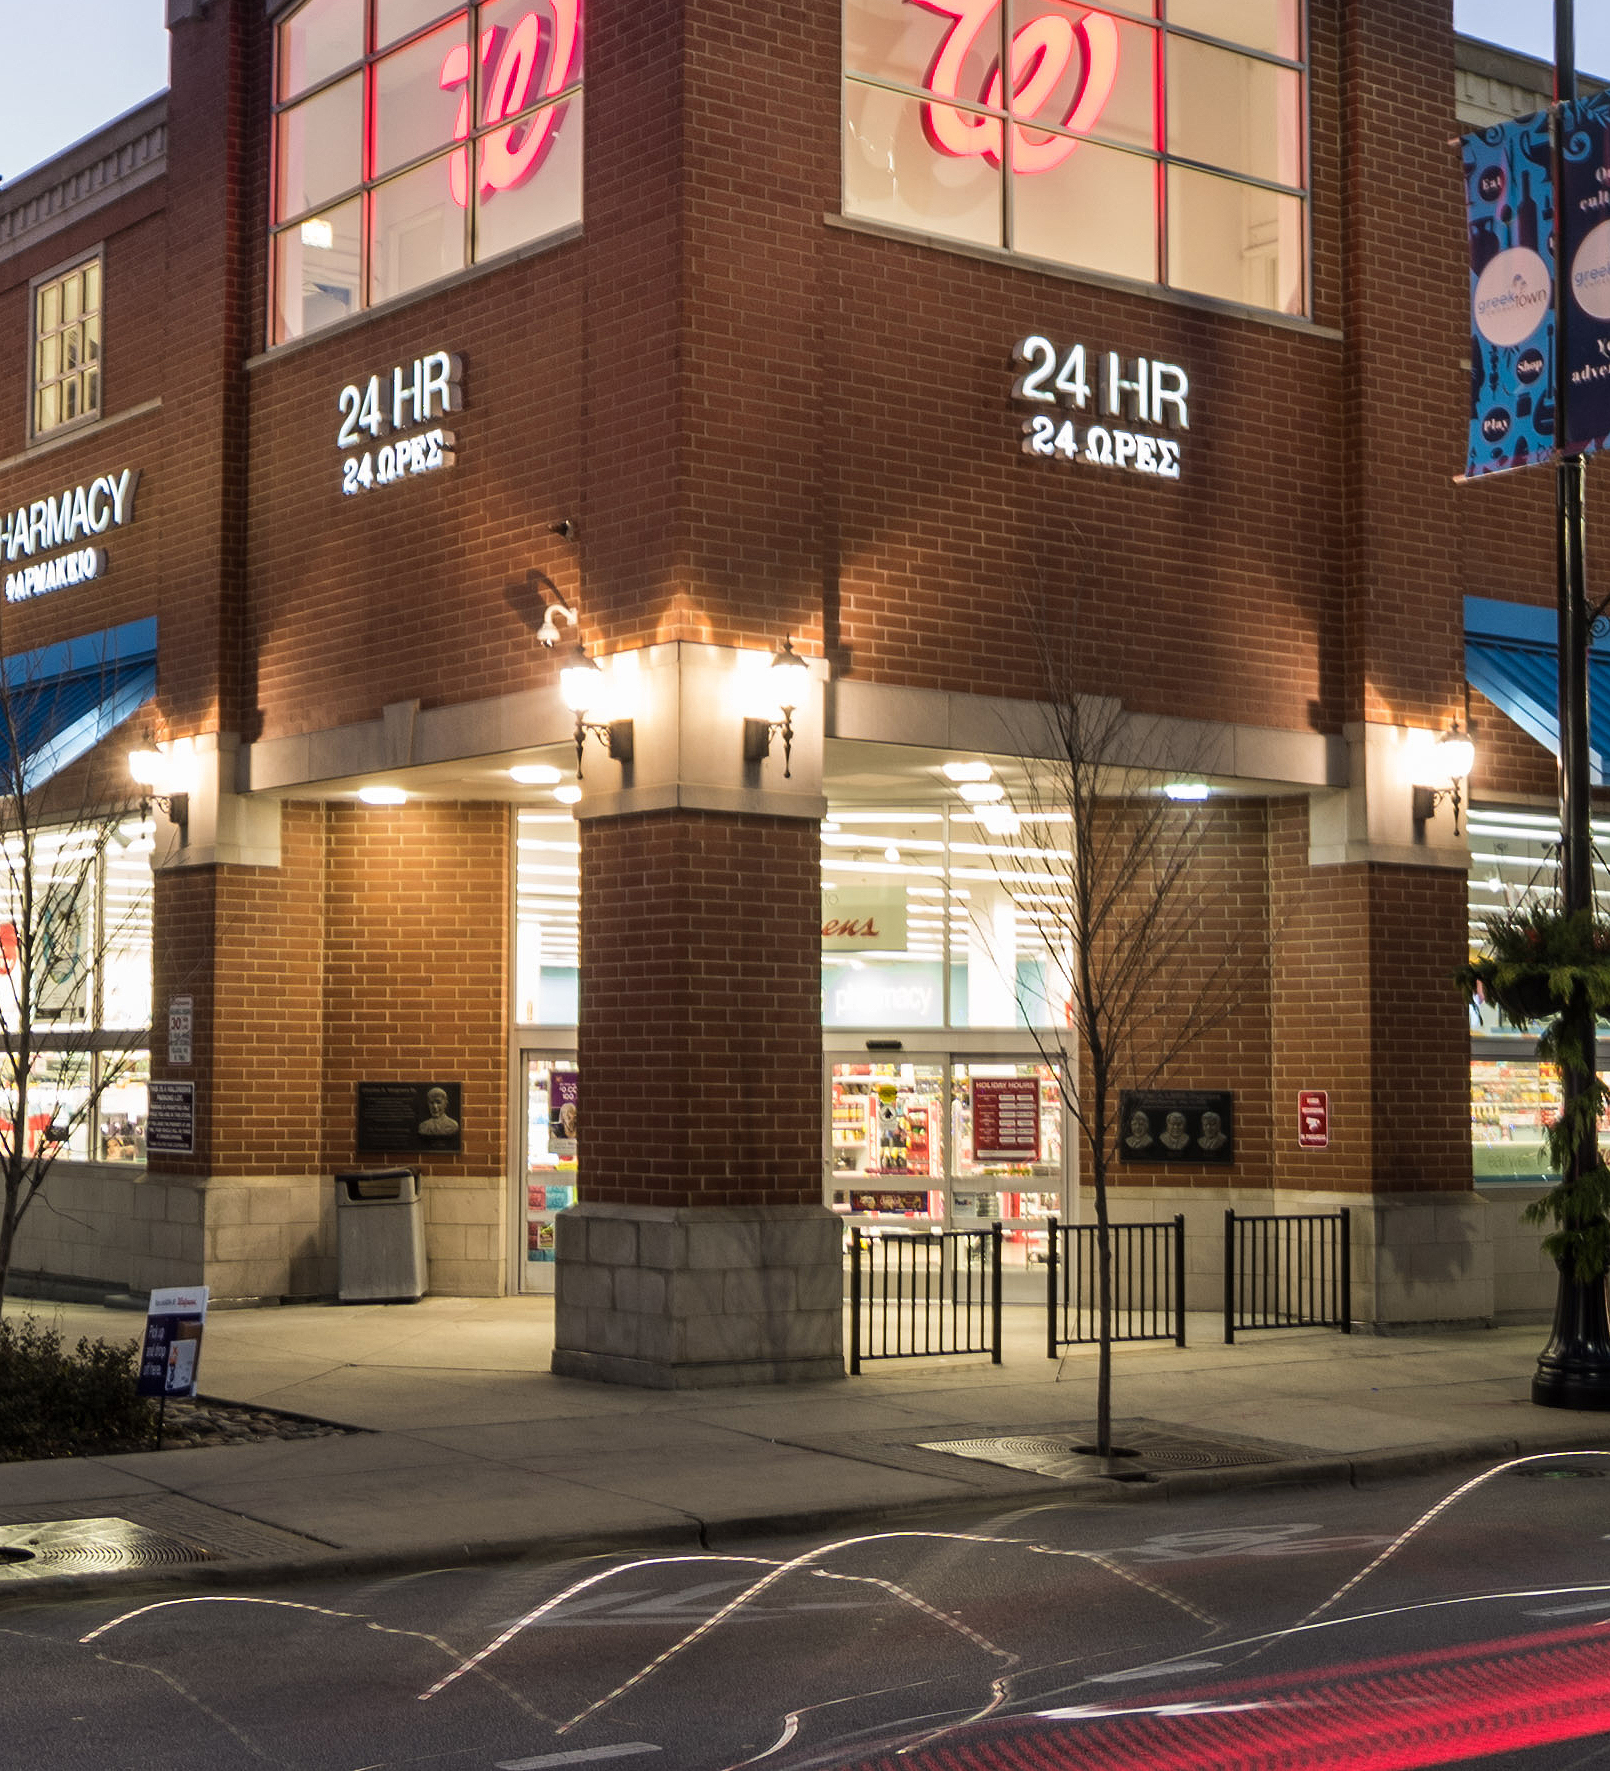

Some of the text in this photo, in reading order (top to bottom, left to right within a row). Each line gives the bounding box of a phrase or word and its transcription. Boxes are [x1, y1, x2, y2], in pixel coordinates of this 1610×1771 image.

[1482, 176, 1502, 191] Eat
[1477, 288, 1547, 314] greektown
[1022, 335, 1189, 430] 24 HR
[1517, 359, 1543, 374] Shop
[337, 351, 451, 449] 24 HR
[1484, 417, 1508, 432] Play
[342, 429, 444, 495] 24 ΩΡΕΣ
[1032, 415, 1181, 480] 24 ΩΡΕΣ
[835, 981, 933, 1017] phmacy
